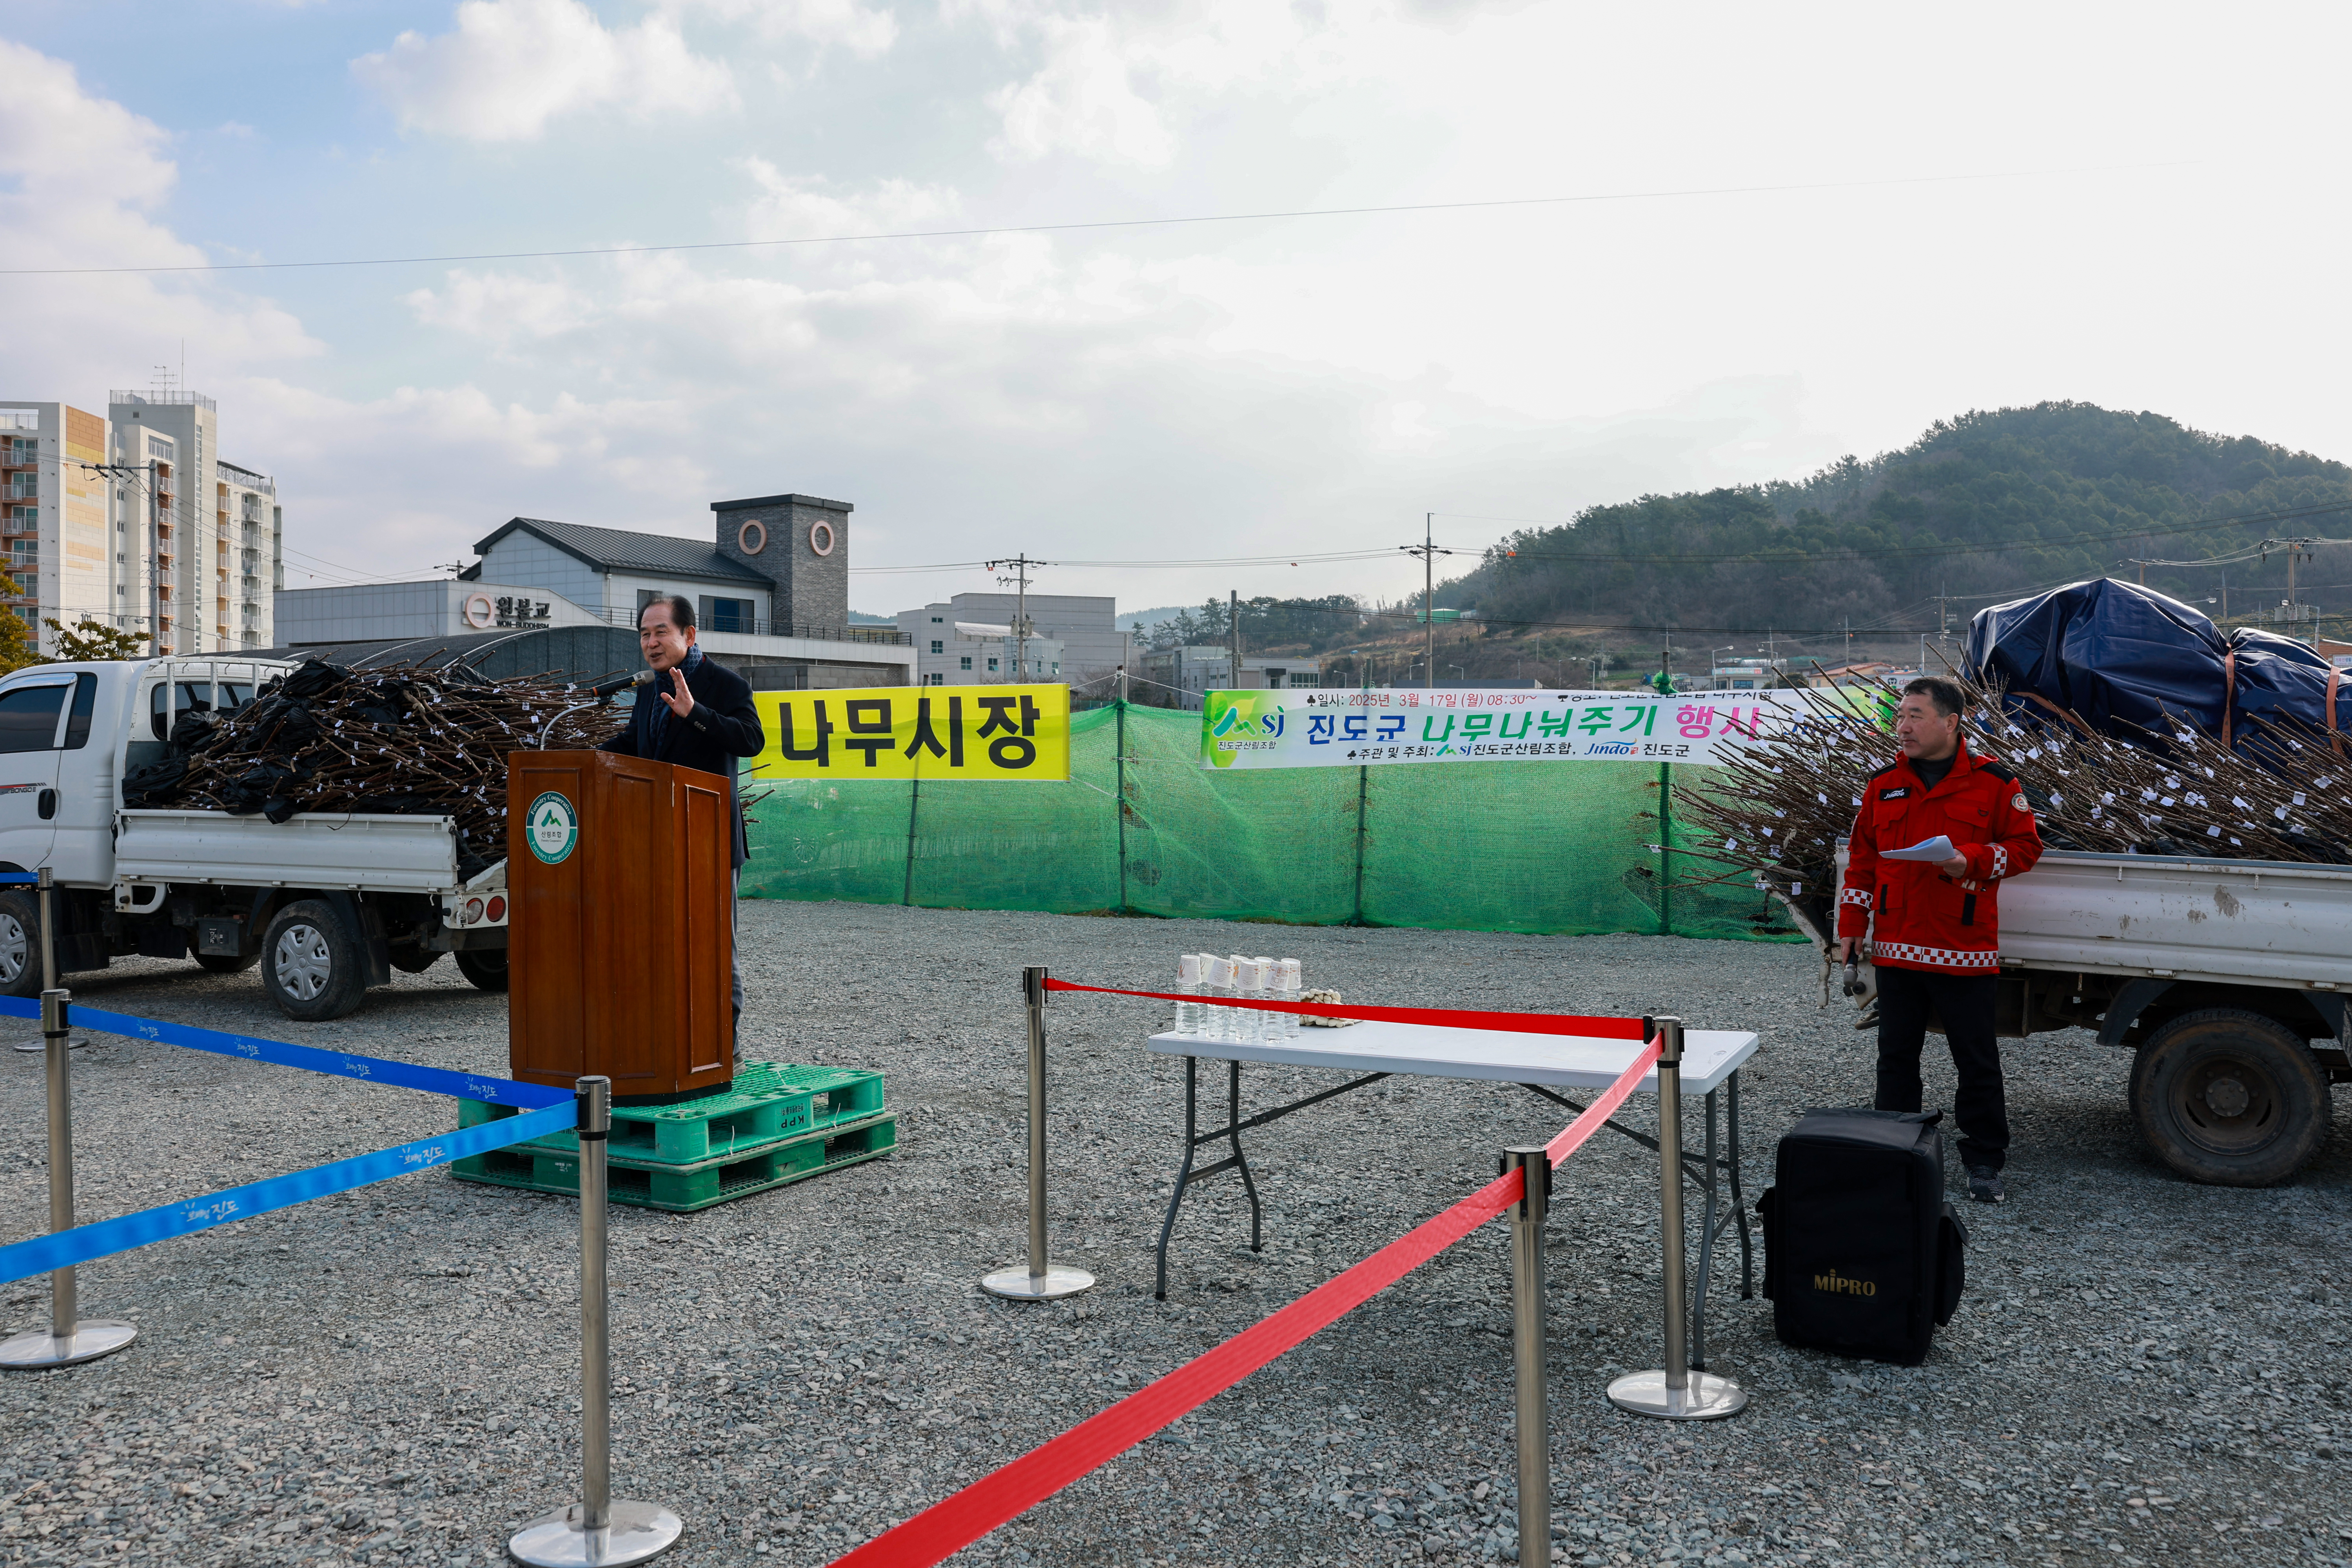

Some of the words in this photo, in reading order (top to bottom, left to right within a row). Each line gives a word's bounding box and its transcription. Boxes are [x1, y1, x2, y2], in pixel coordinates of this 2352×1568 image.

[496, 597, 551, 620] 원불교
[1318, 694, 1344, 707] 일시:
[1349, 694, 1390, 707] 2025년
[1399, 694, 1419, 707] 3월
[1430, 694, 1457, 707] 17일
[1461, 693, 1483, 708] (월)
[1488, 695, 1537, 706] 08:30~
[779, 695, 1040, 769] 나무시장
[1307, 715, 1406, 745] 진도군
[1423, 705, 1658, 742] 나무나눠주기
[1676, 704, 1762, 741] 행사
[1218, 740, 1277, 751] 진도군산림조합
[1359, 748, 1383, 760] 주관
[1388, 747, 1399, 759] 및
[1403, 746, 1435, 758] 주최:
[1474, 742, 1576, 756] 진도군산림조합,
[1643, 743, 1690, 757] 진도군
[530, 796, 546, 815] Forestry
[547, 794, 572, 815] Cooperative
[531, 841, 547, 861] Forestry
[548, 841, 573, 861] Cooperative
[148, 1027, 160, 1038] 진도
[247, 1045, 260, 1056] 진도
[357, 1064, 371, 1077] 진도
[482, 1085, 498, 1099] 진도
[781, 1114, 804, 1129] KPP
[423, 1146, 445, 1164] 진도
[211, 1200, 240, 1221] 진도
